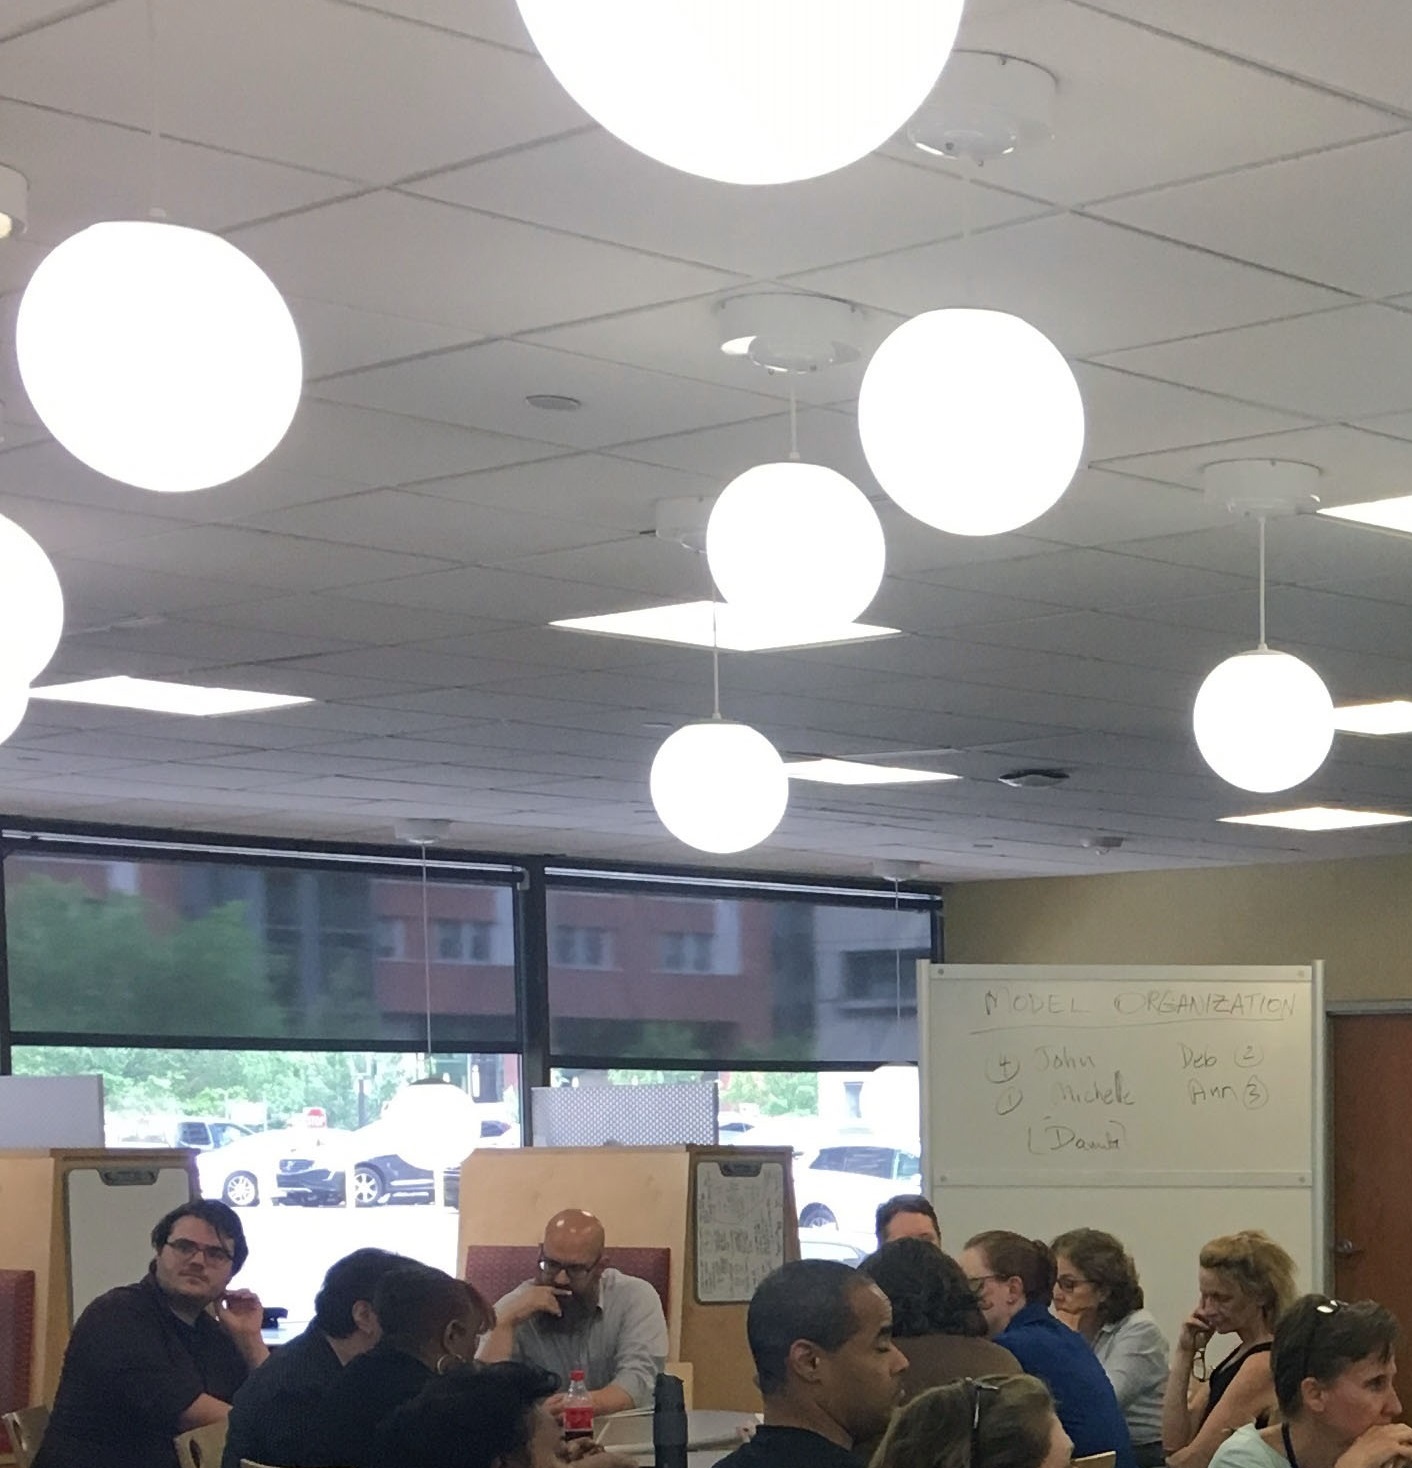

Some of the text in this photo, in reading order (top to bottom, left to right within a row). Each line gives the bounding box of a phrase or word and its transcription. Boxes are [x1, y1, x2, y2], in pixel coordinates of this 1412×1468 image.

[984, 986, 1296, 1016] MODEL ORGANIZATION
[1034, 1045, 1096, 1072] John
[1177, 1042, 1218, 1070] Deb
[1187, 1078, 1239, 1106] Ann
